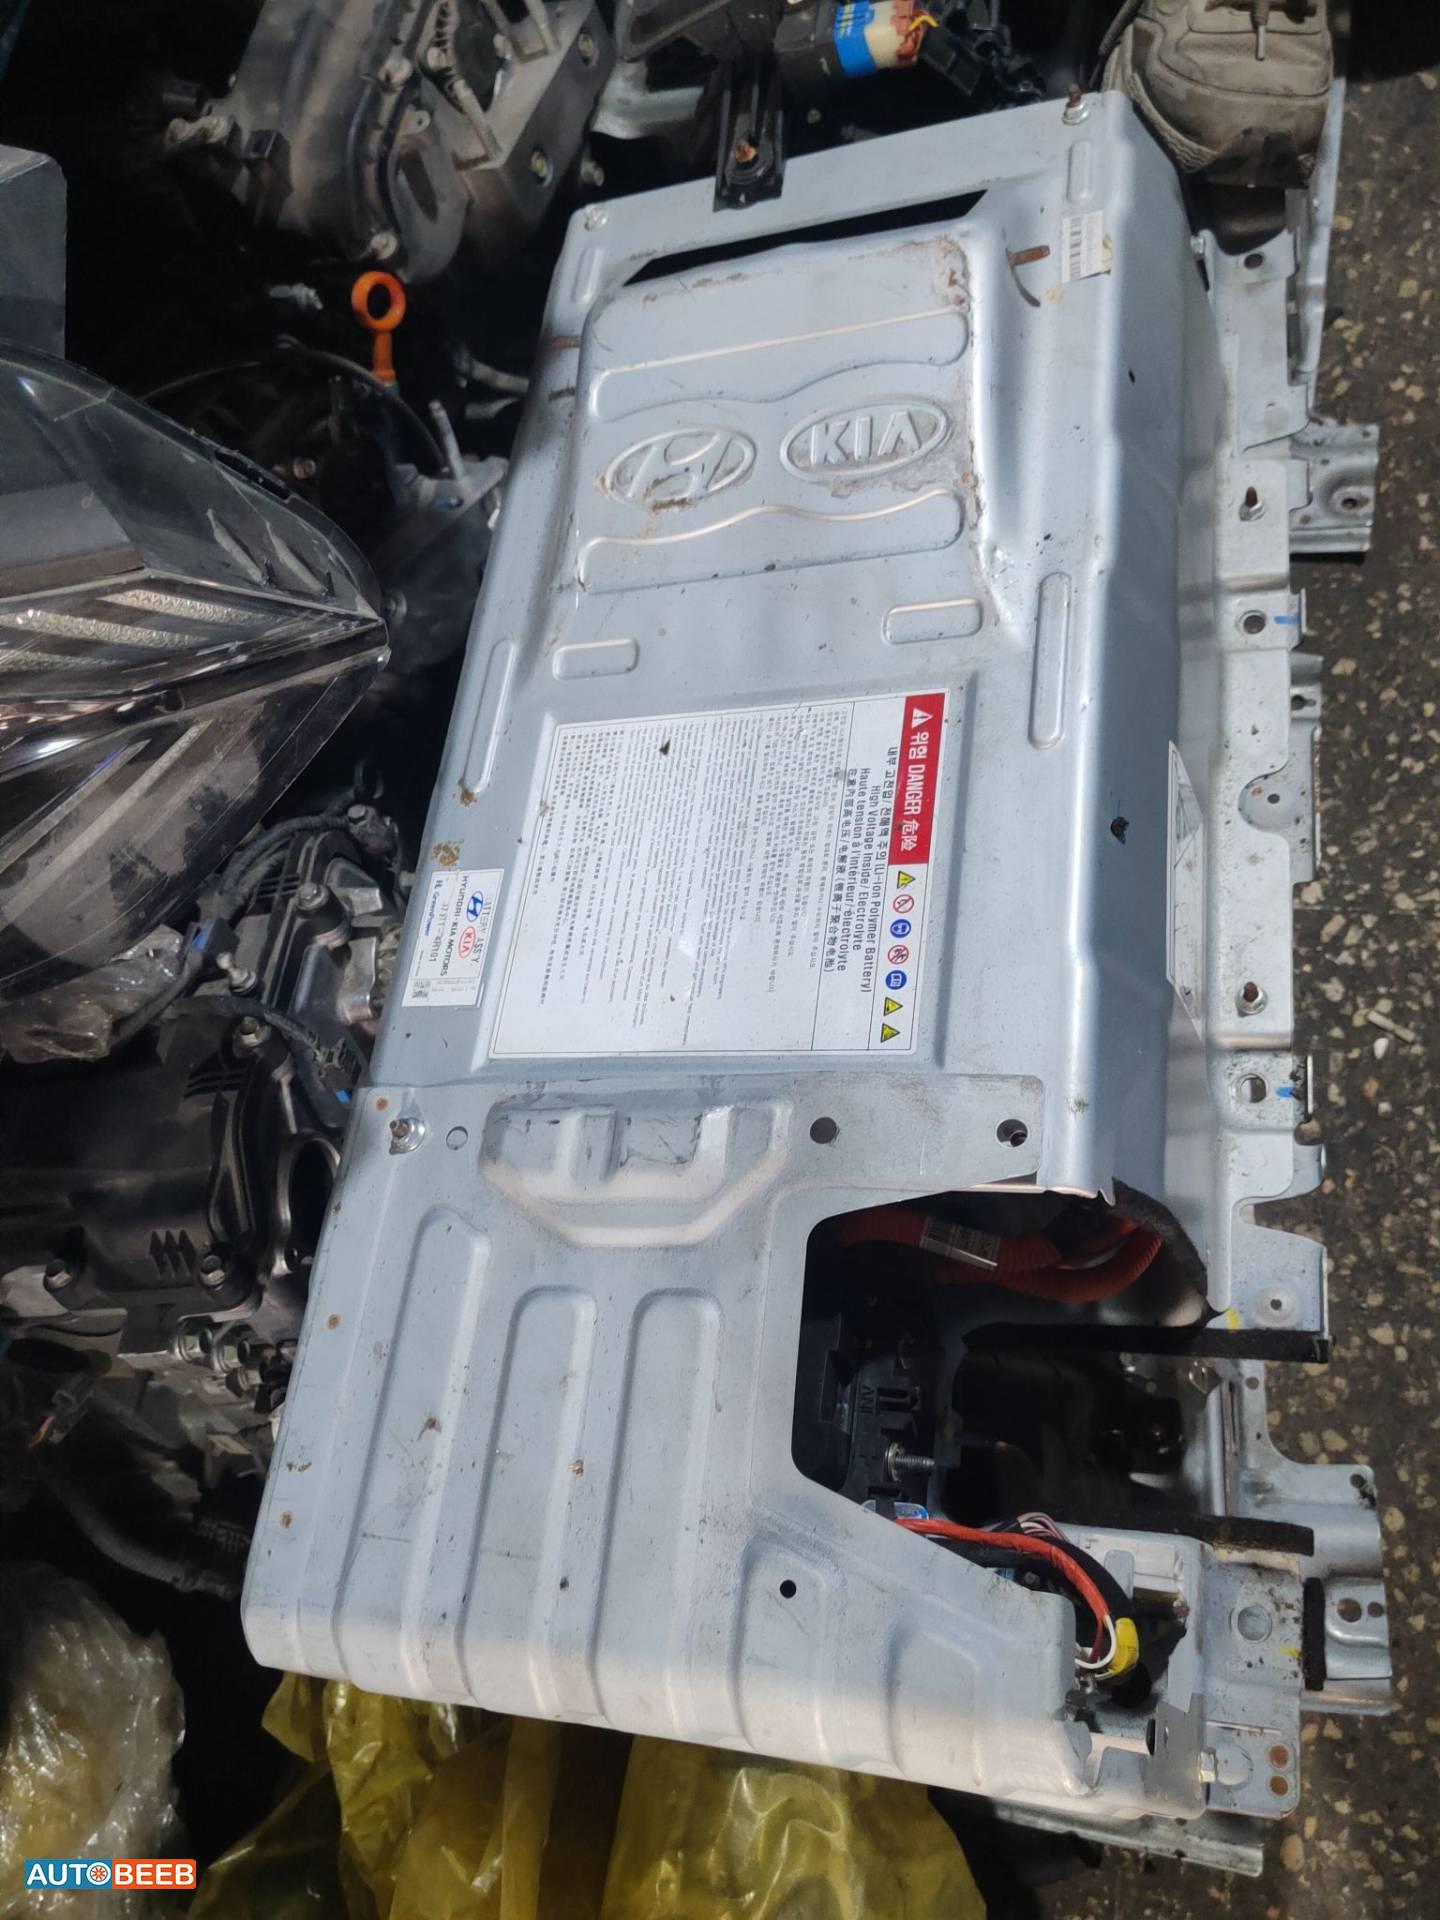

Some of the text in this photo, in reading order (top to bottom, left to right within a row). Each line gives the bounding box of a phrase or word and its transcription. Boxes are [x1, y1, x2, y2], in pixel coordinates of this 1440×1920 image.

[810, 411, 922, 465] KIA
[885, 746, 898, 765] 내부
[908, 730, 929, 759] 위험
[857, 767, 870, 797] Haute
[868, 785, 880, 807] High
[903, 764, 925, 814] DANGER
[852, 799, 866, 838] tension
[862, 810, 878, 849] Voltage
[875, 840, 887, 860] 주의
[851, 891, 868, 950] Electrolyte
[865, 901, 880, 943] Polymer
[440, 938, 454, 976] MOTORS
[460, 932, 472, 952] KIA
